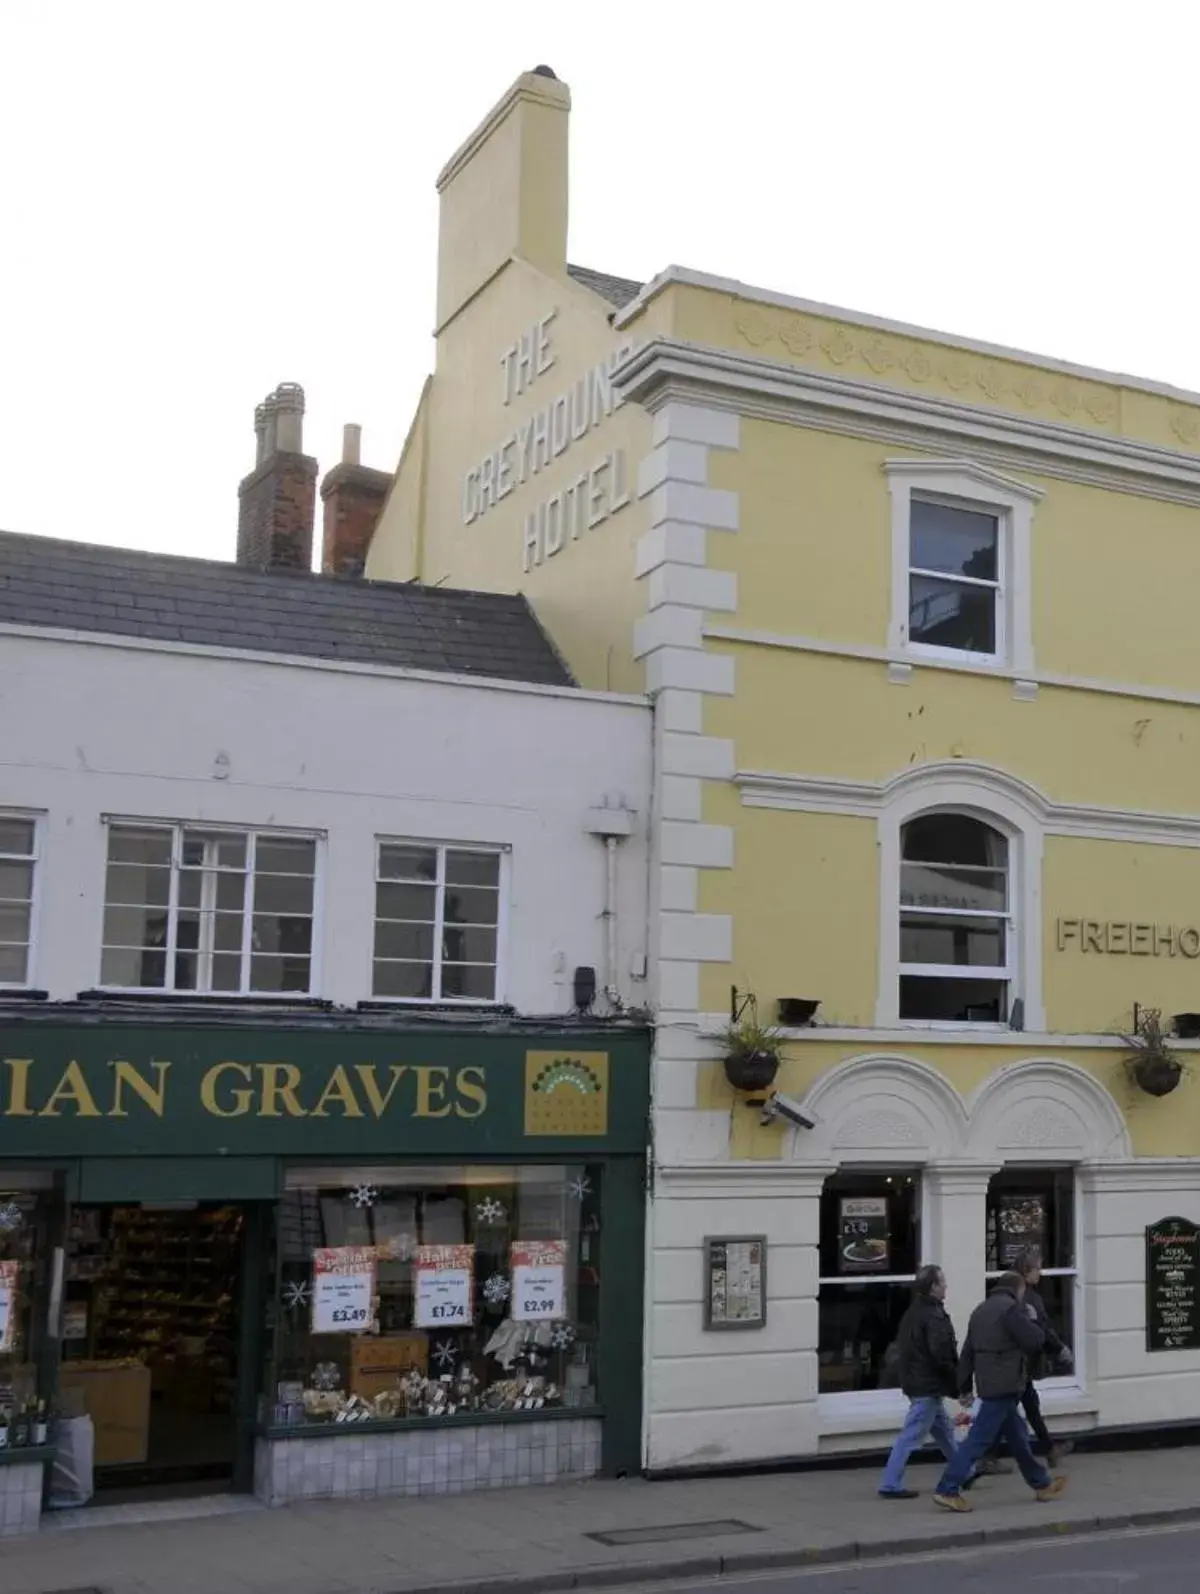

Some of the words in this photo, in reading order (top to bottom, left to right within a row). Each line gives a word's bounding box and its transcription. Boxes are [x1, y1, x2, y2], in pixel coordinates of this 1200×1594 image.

[500, 307, 557, 406] THE
[523, 450, 632, 573] HOTEL
[3, 1058, 172, 1117] IAN
[200, 1061, 488, 1119] GRAVES
[332, 1308, 366, 1322] £3.49
[431, 1304, 465, 1318] £1.74
[523, 1299, 555, 1313] £2.99
